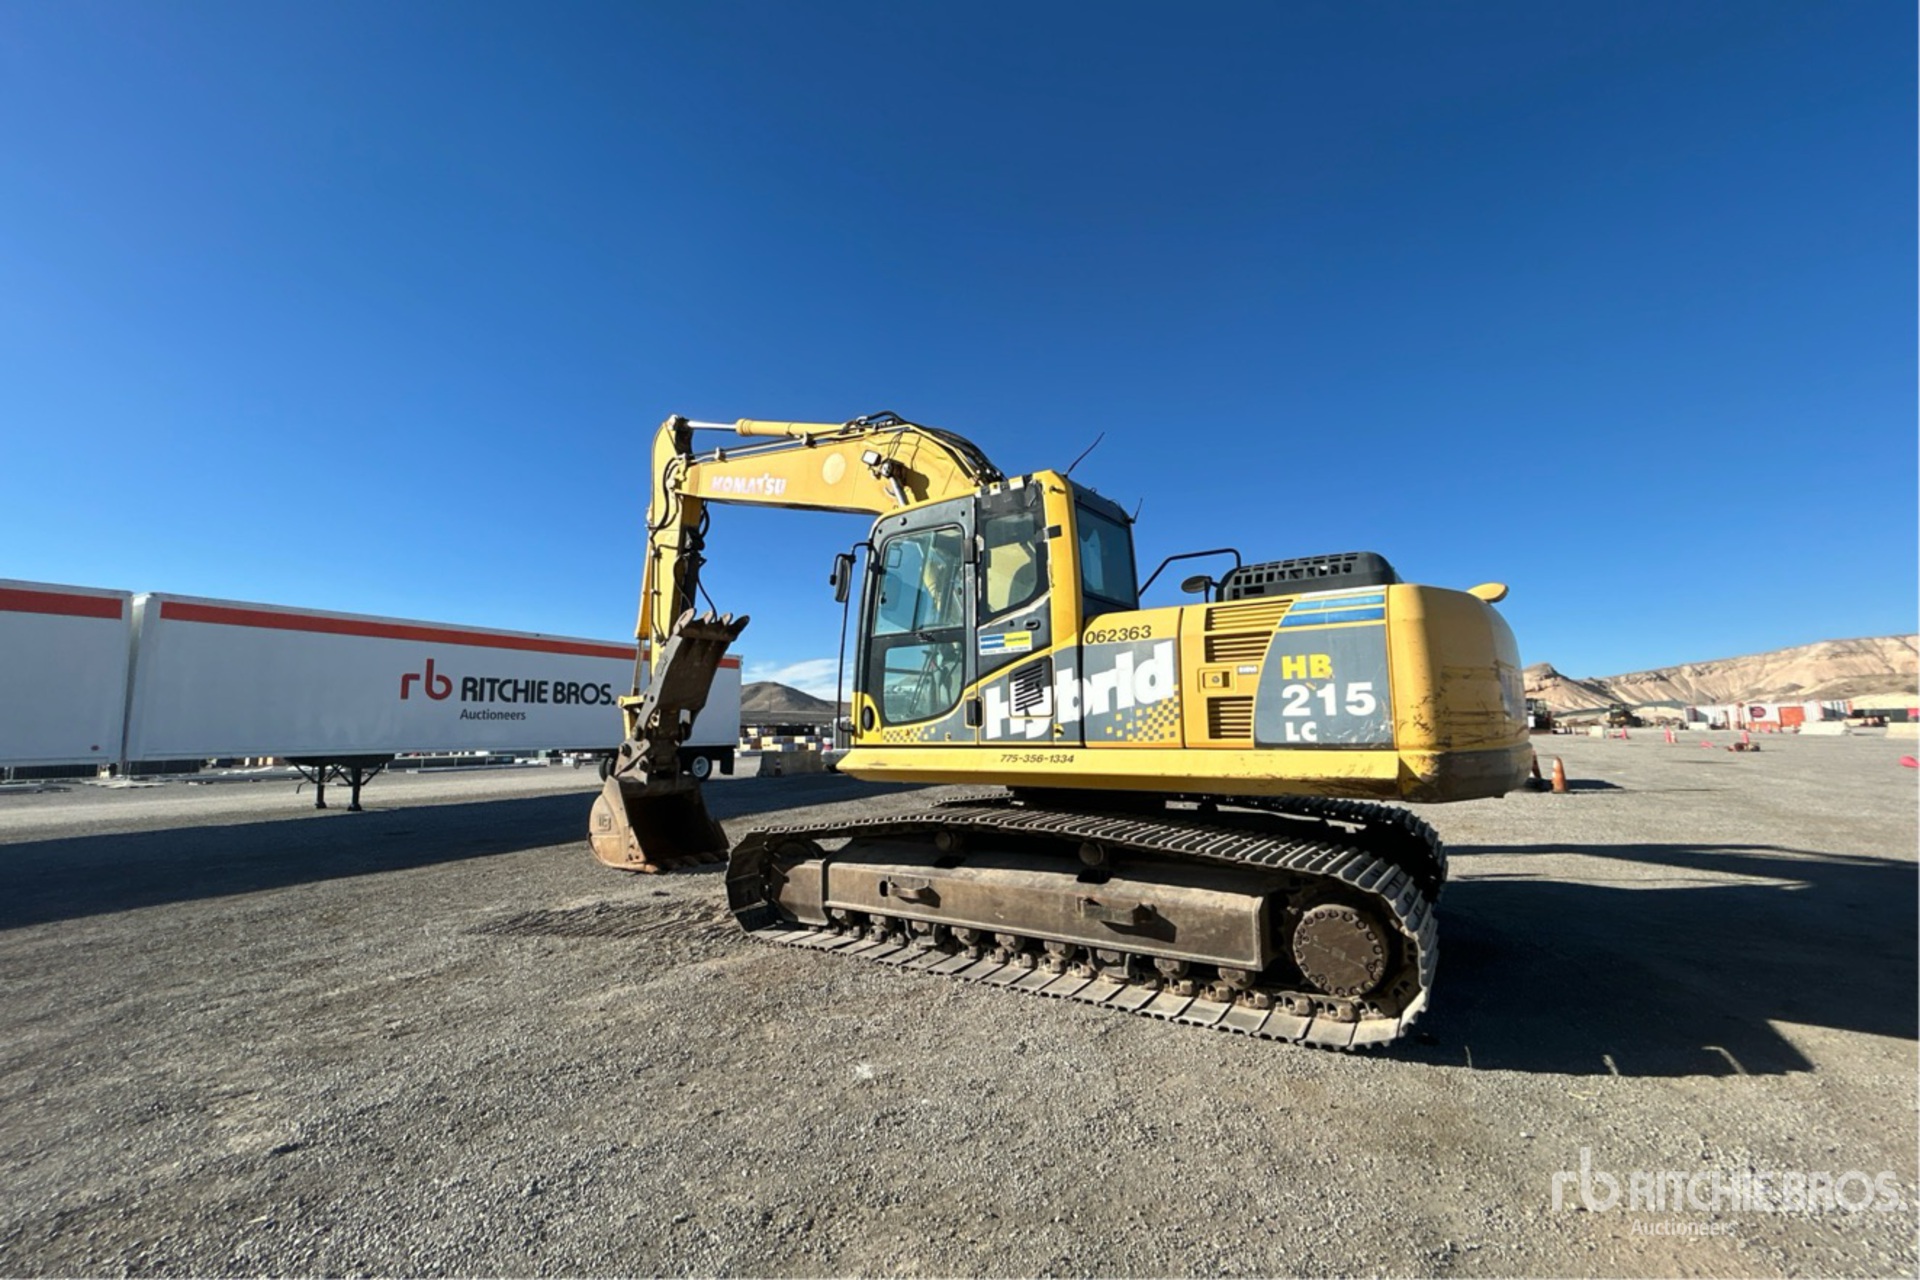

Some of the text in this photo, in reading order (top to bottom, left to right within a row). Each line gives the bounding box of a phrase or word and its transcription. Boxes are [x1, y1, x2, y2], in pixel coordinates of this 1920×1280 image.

[710, 473, 787, 496] KOMATSU
[1085, 625, 1151, 645] 062363
[400, 658, 453, 700] rb
[1281, 654, 1332, 680] HB
[461, 676, 617, 705] RITCHIE BROS.
[985, 640, 1174, 740] Hybrid
[1281, 682, 1376, 717] 215
[460, 708, 526, 721] Auctioneers
[1285, 721, 1317, 742] LC
[1000, 754, 1075, 763] 775-356-1334
